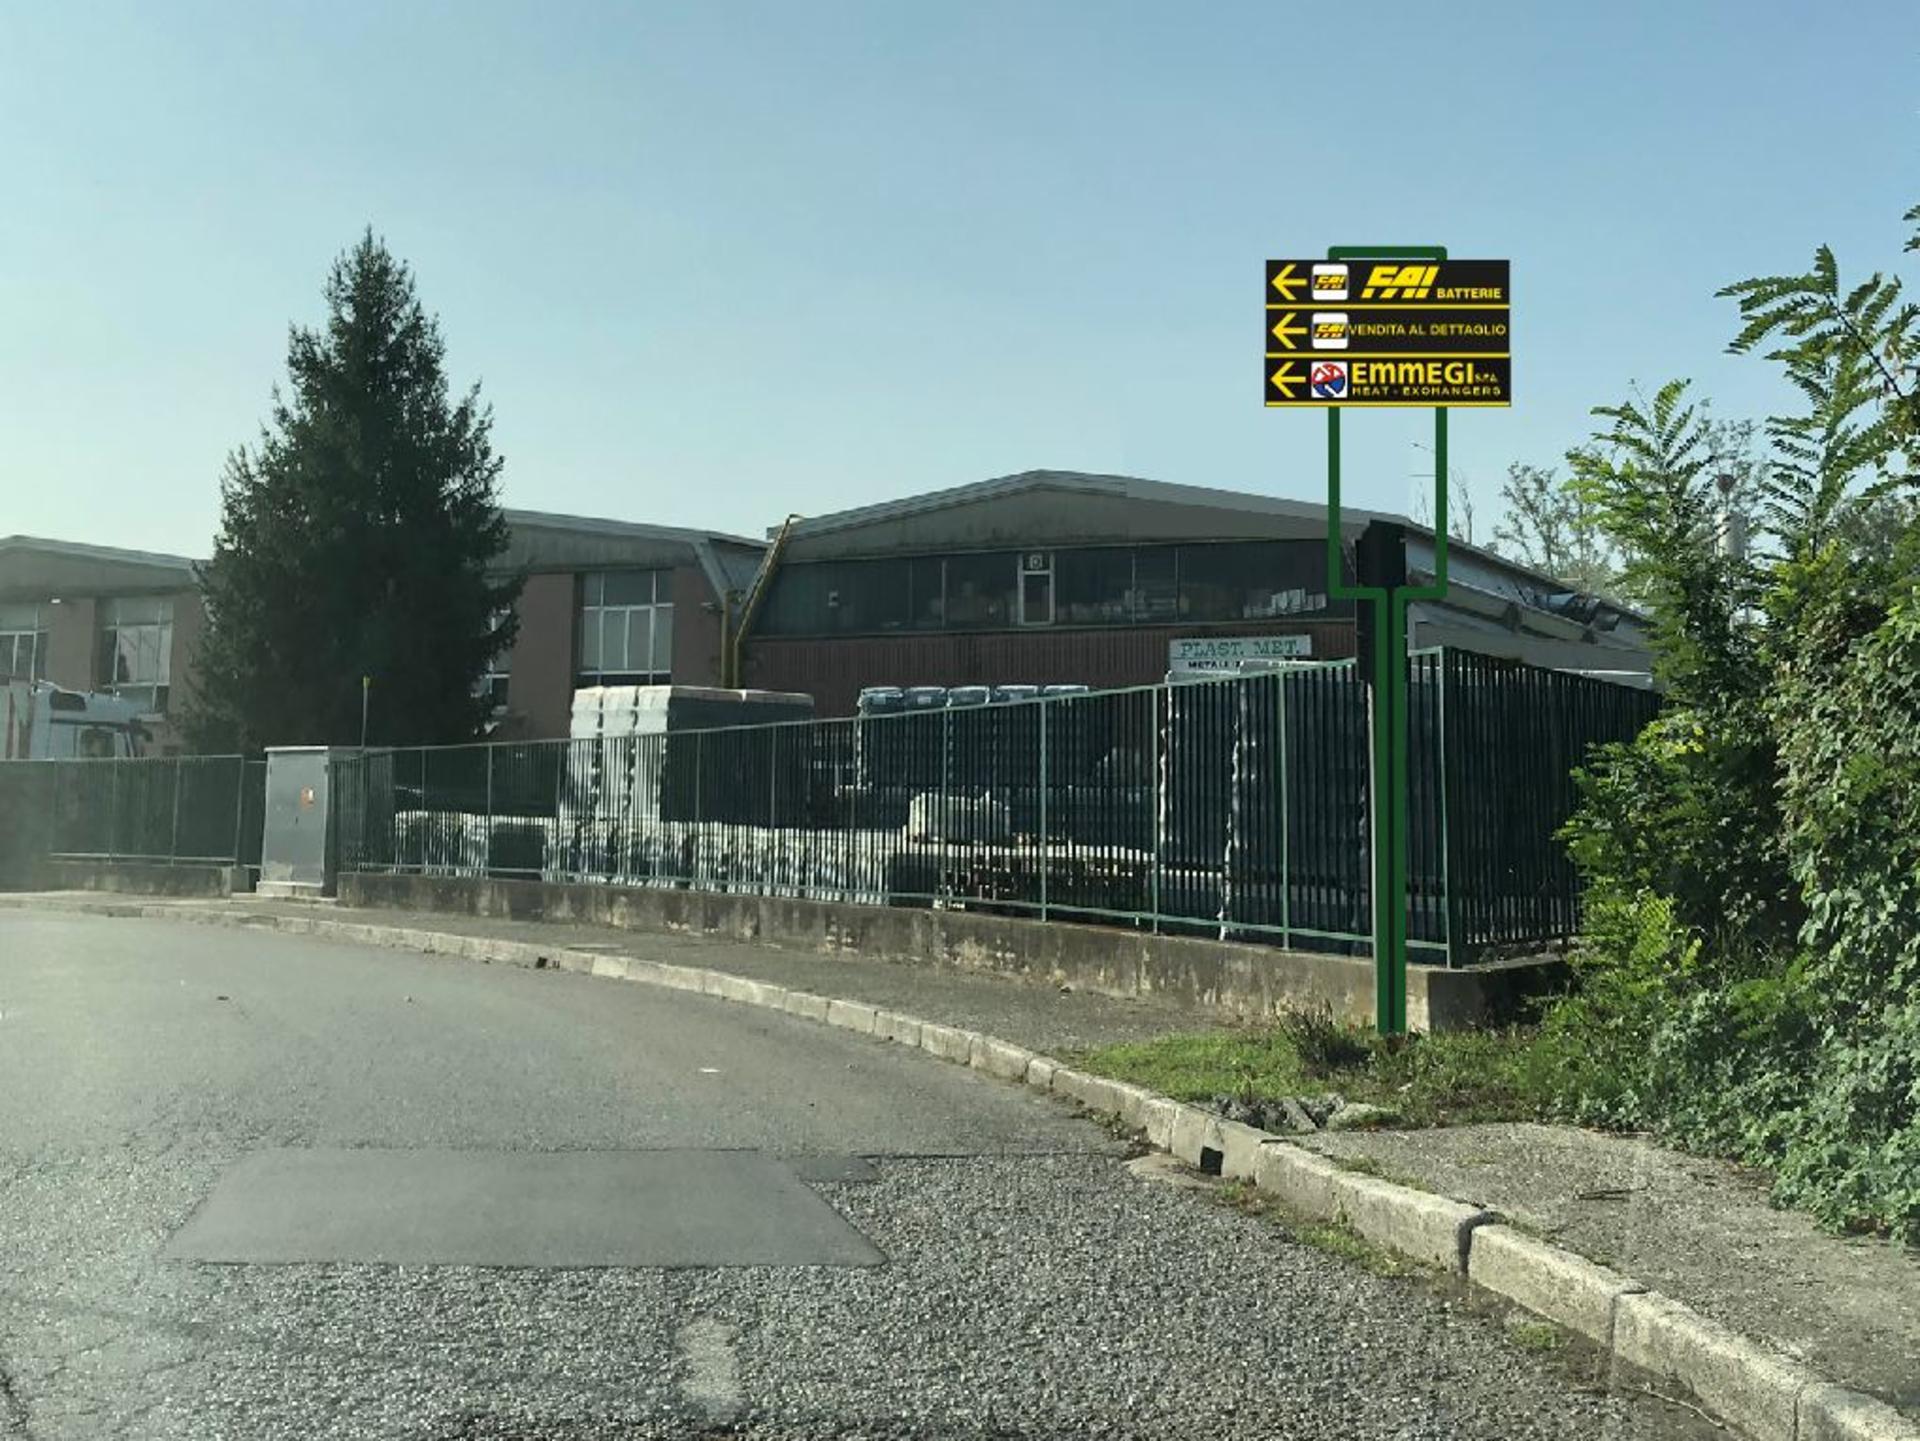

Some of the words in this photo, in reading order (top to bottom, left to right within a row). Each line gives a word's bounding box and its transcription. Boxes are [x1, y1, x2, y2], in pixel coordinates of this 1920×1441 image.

[1361, 265, 1440, 299] FAI
[1437, 287, 1502, 299] BATTERIE
[1349, 323, 1405, 336] VENDITA
[1409, 323, 1426, 336] AL
[1430, 323, 1507, 336] DETTAGLIO
[1352, 362, 1474, 385] EMMEGI
[1352, 386, 1388, 396] HEAT
[1403, 386, 1501, 396] EXCHANGERS
[1180, 641, 1245, 657] PLAST.
[1254, 639, 1300, 656] MET.
